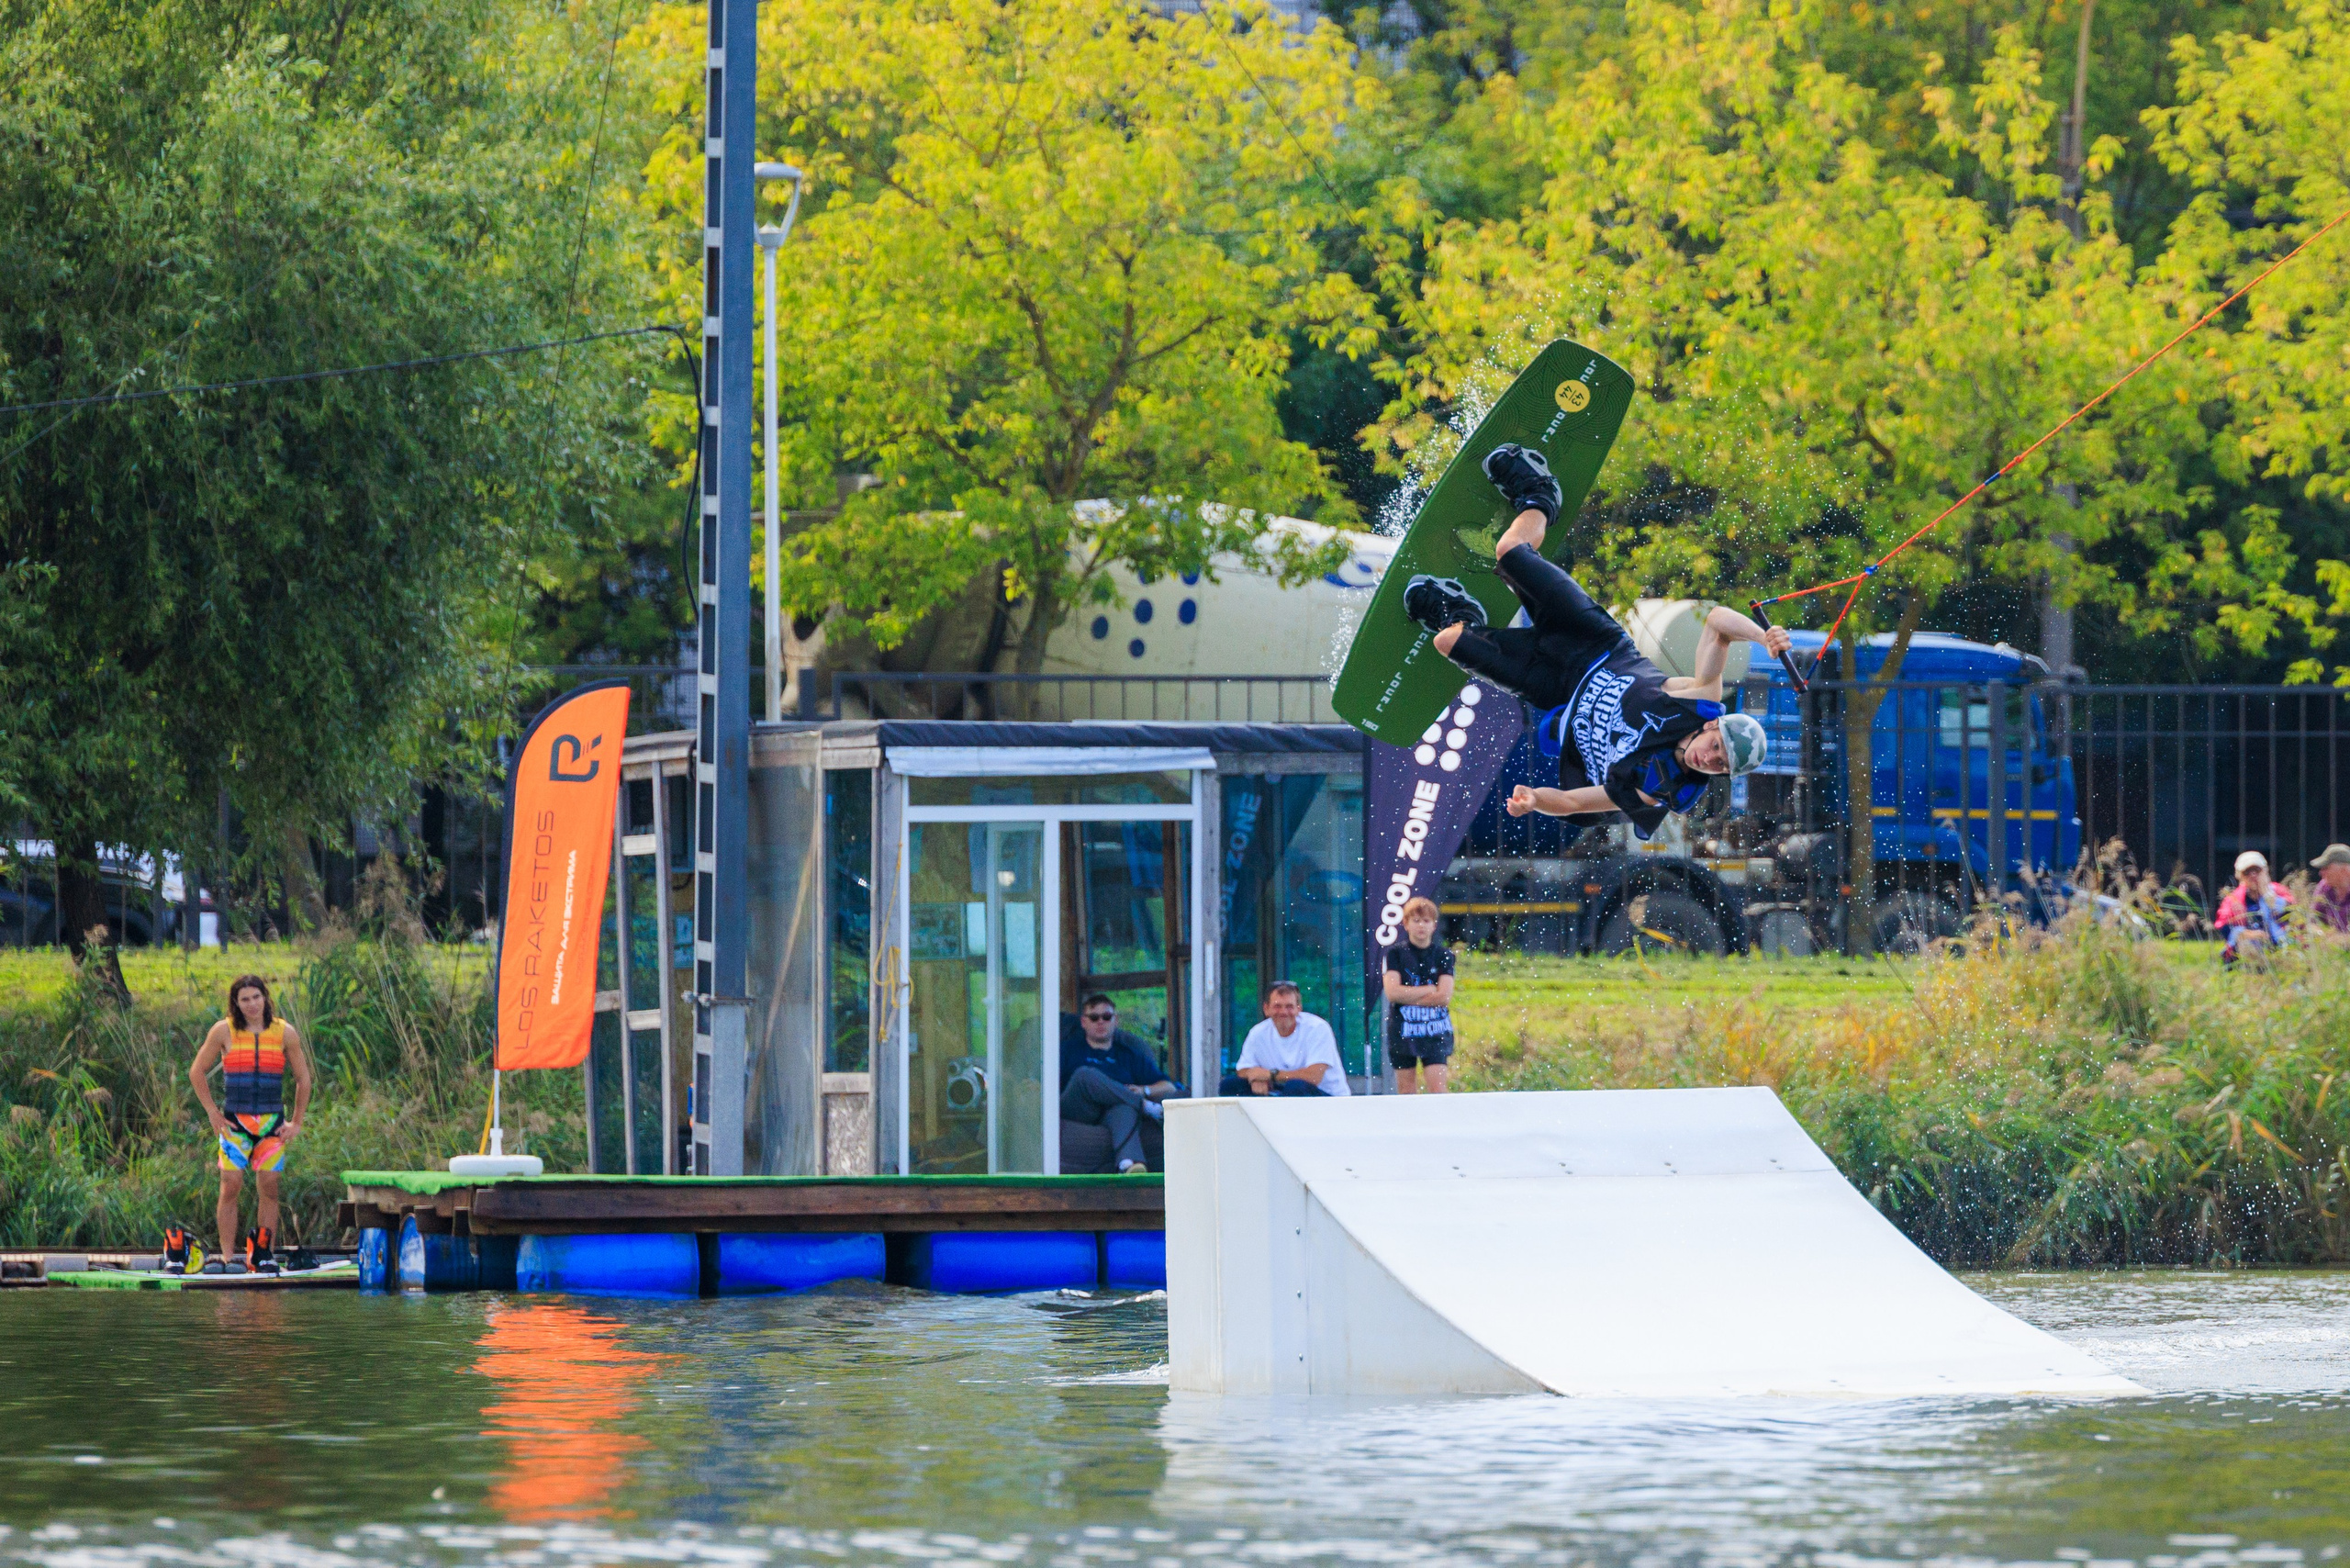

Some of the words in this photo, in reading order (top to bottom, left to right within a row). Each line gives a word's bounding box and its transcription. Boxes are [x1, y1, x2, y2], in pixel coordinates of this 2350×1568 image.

[1559, 386, 1572, 399] 44
[1572, 392, 1584, 407] 43
[1404, 629, 1429, 665] rano
[1577, 667, 1616, 716] OPEN
[1361, 718, 1380, 732] 150
[1225, 791, 1262, 869] ZONE
[1396, 778, 1441, 862] ZONE
[525, 809, 555, 977] RAKETOS
[1375, 867, 1418, 946] COOL
[550, 951, 565, 1005] ЗАЩИТА
[564, 849, 578, 920] ЭКСТРИМА
[514, 986, 539, 1050] LOS
